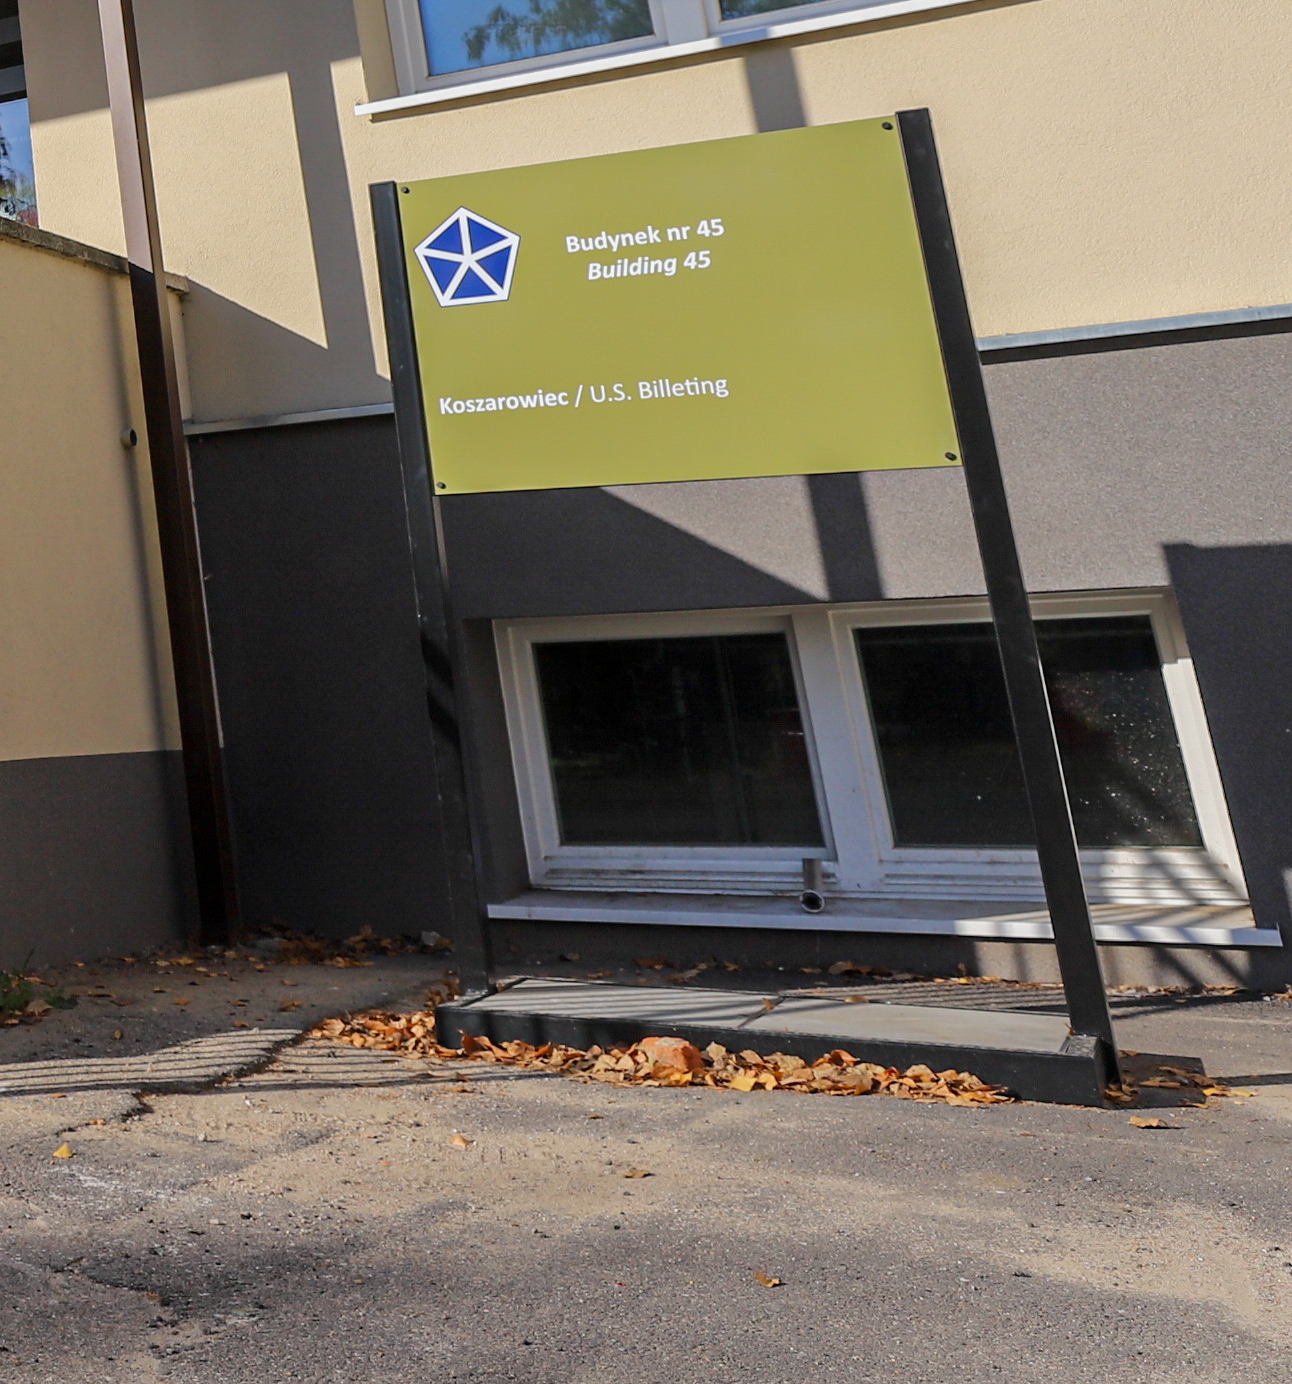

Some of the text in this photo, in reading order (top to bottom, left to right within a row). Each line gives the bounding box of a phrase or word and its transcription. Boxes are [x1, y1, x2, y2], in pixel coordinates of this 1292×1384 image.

[565, 218, 725, 253] Budynek nr 45
[587, 250, 711, 280] Building 45
[439, 377, 730, 415] Koszarowiec / U.S. Billeting
